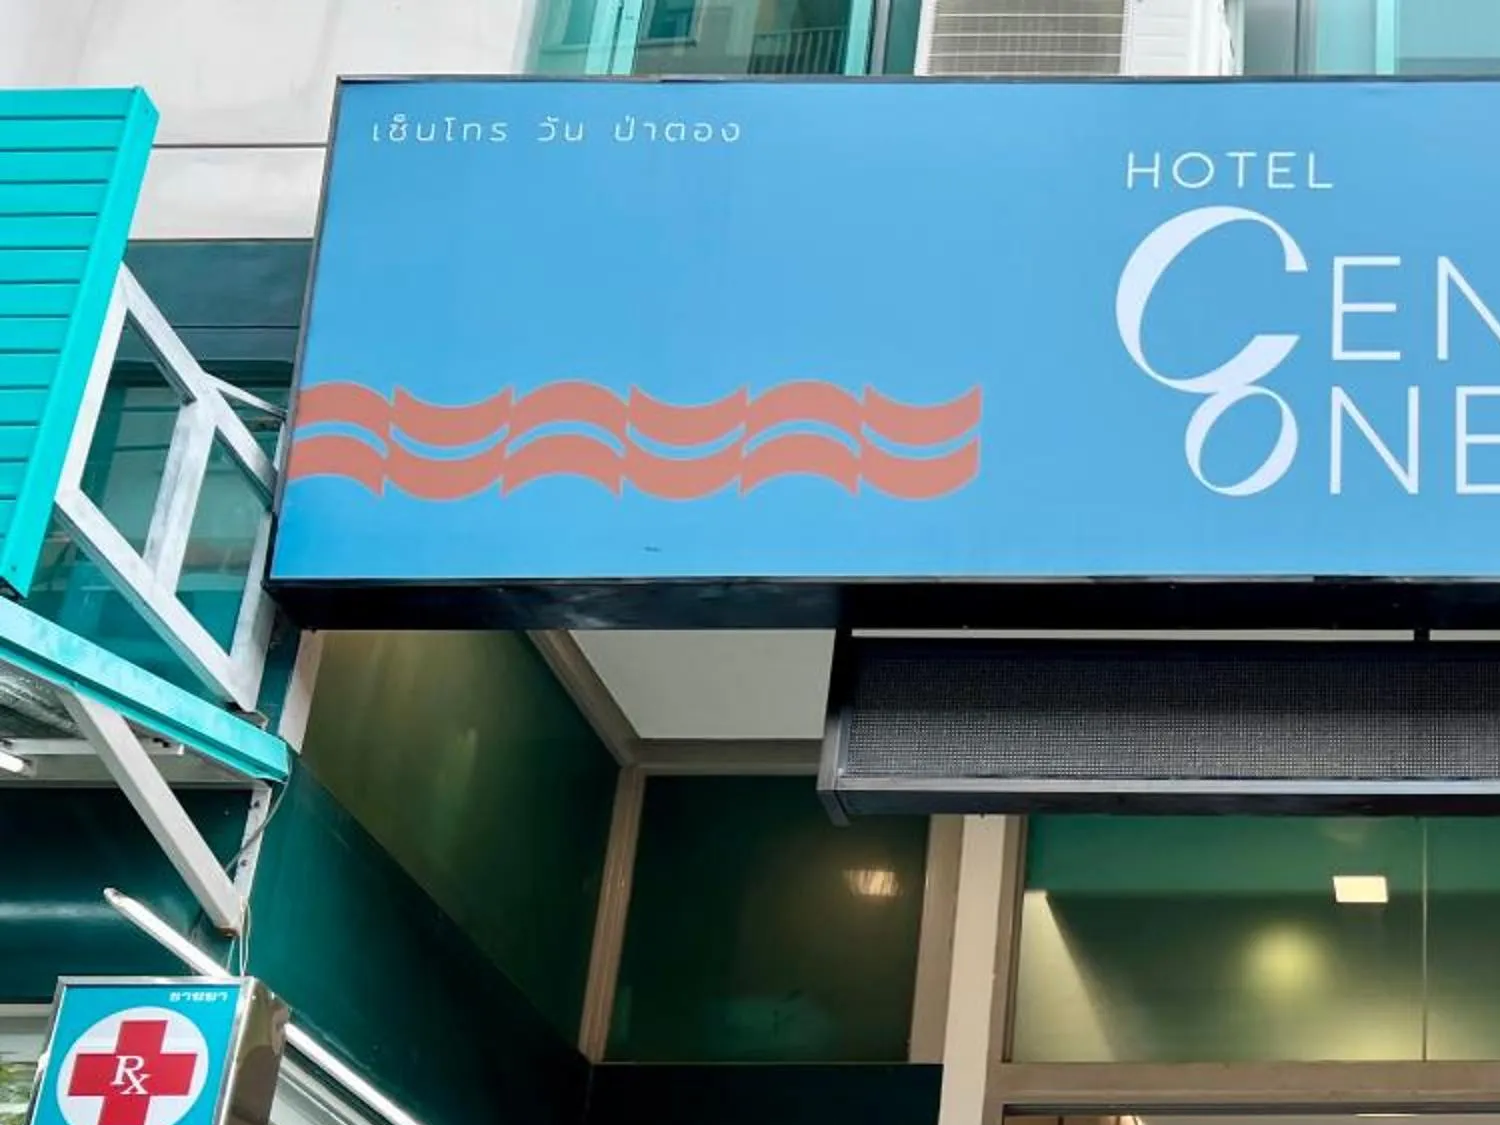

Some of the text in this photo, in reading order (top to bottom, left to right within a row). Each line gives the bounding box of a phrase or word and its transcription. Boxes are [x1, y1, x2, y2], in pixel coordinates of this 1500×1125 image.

[536, 115, 584, 142] วัน
[613, 115, 741, 142] ป่าตอง
[1126, 151, 1334, 189] HOTEL
